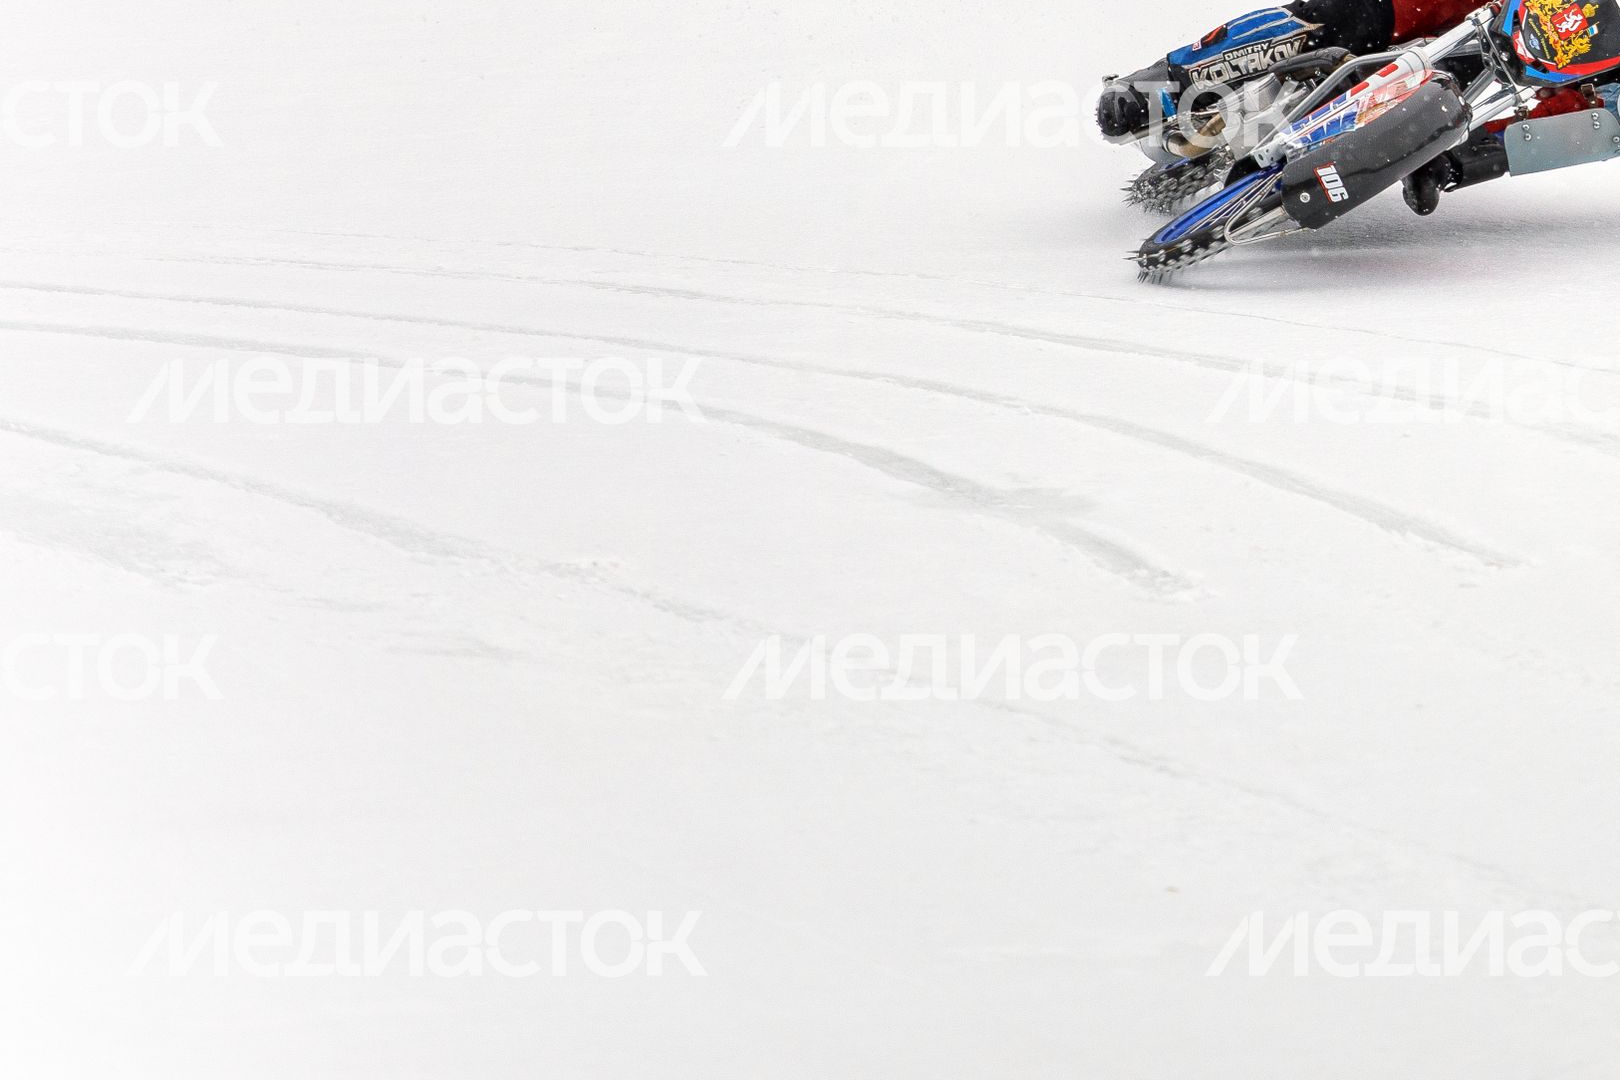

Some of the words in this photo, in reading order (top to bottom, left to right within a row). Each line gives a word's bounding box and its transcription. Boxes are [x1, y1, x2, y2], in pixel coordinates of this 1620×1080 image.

[1191, 38, 1304, 91] KOLTAKOV
[1224, 42, 1269, 61] DMITRY
[1317, 164, 1349, 203] 106
